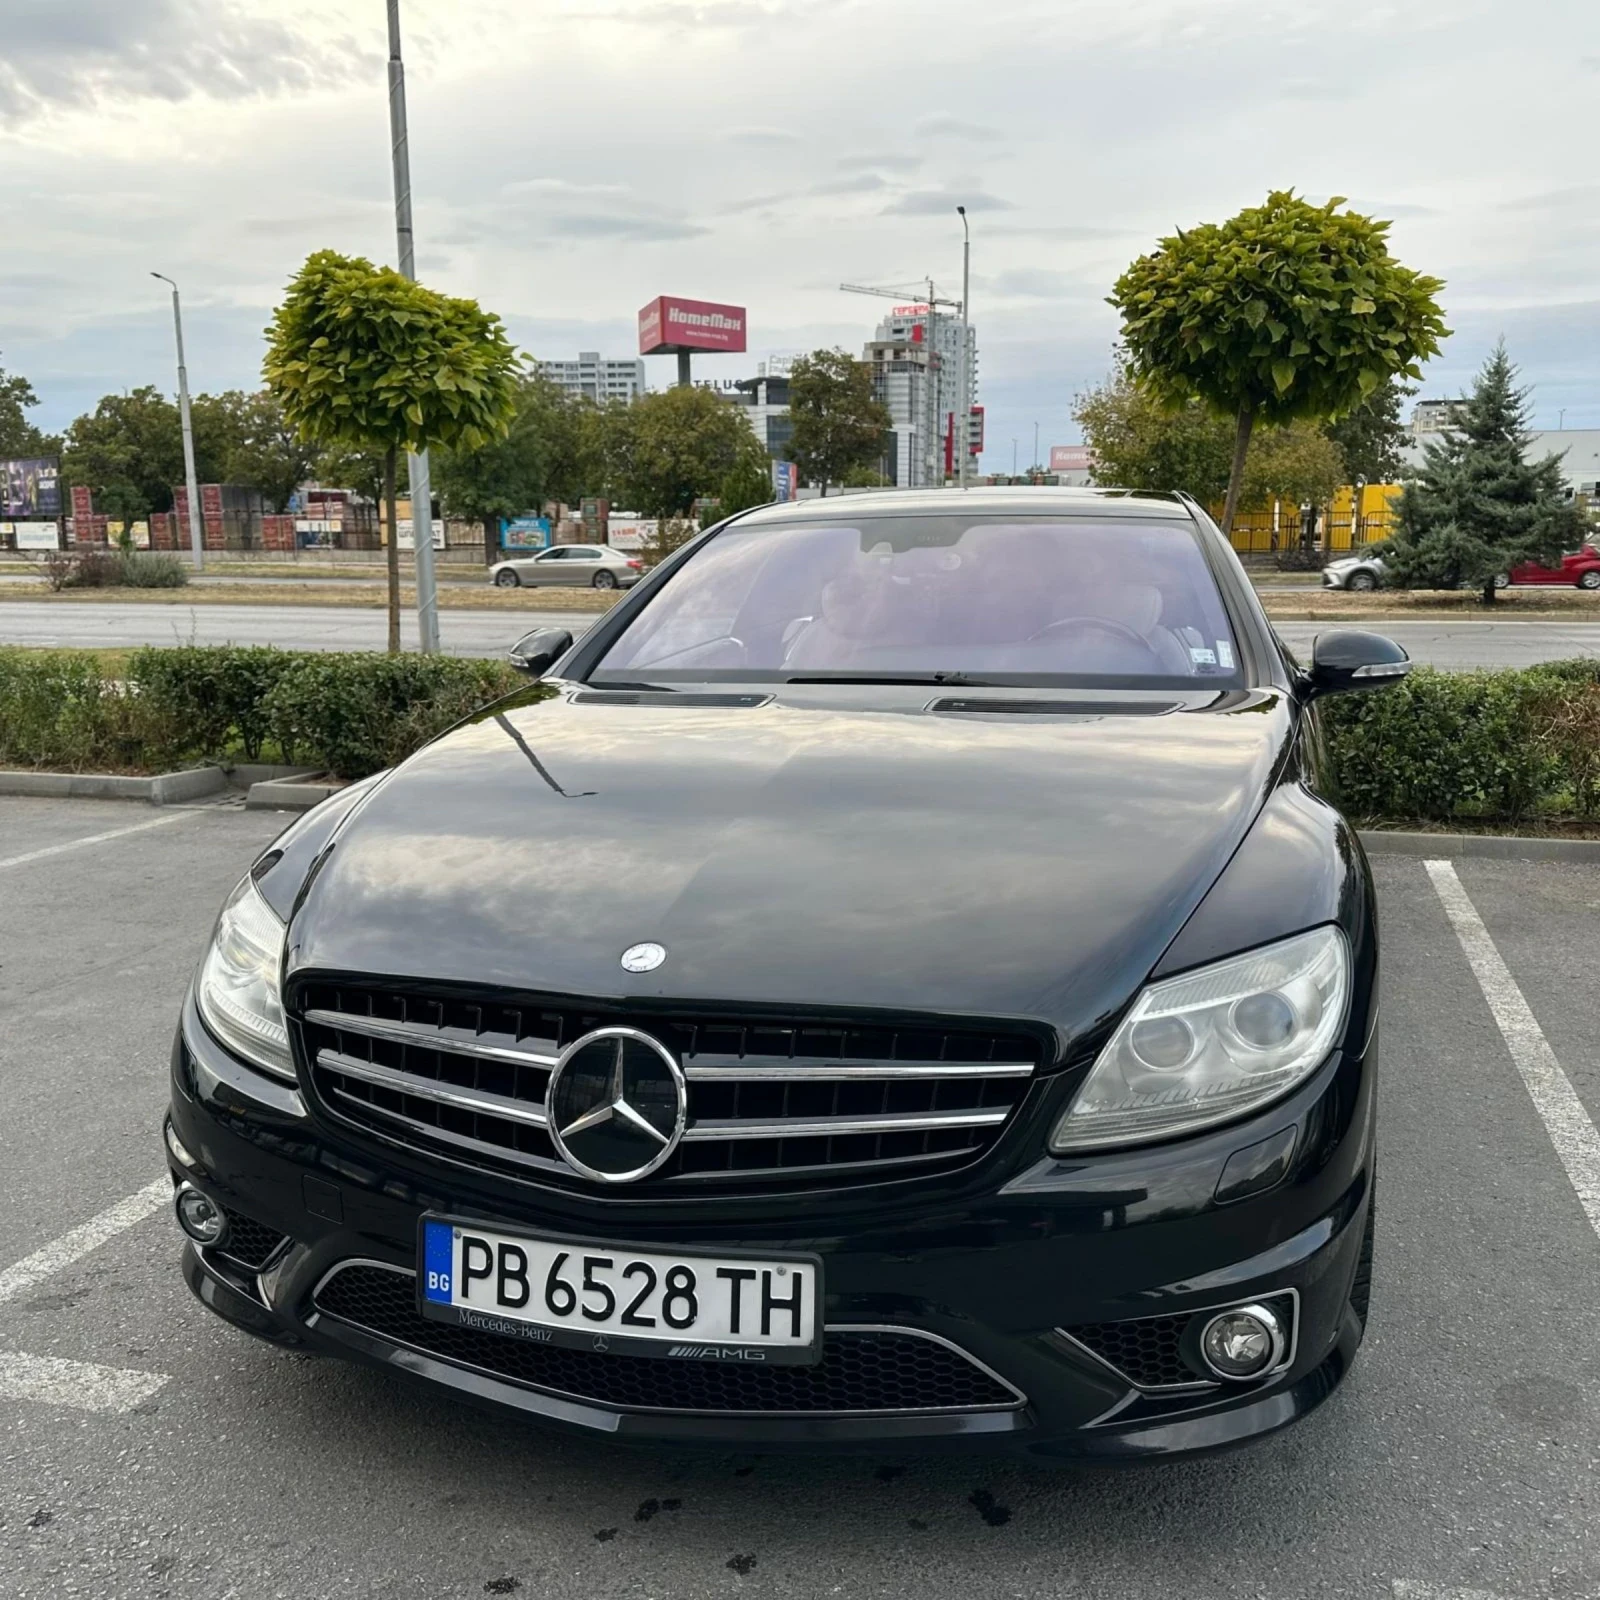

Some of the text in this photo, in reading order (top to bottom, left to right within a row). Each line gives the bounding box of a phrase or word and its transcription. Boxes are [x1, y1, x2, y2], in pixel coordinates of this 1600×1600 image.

[668, 307, 741, 331] HomeMax
[428, 1271, 450, 1292] BG
[462, 1236, 802, 1338] PB 6528 TH
[458, 1309, 553, 1342] Mercedes-Benz
[698, 1347, 766, 1360] AMG
